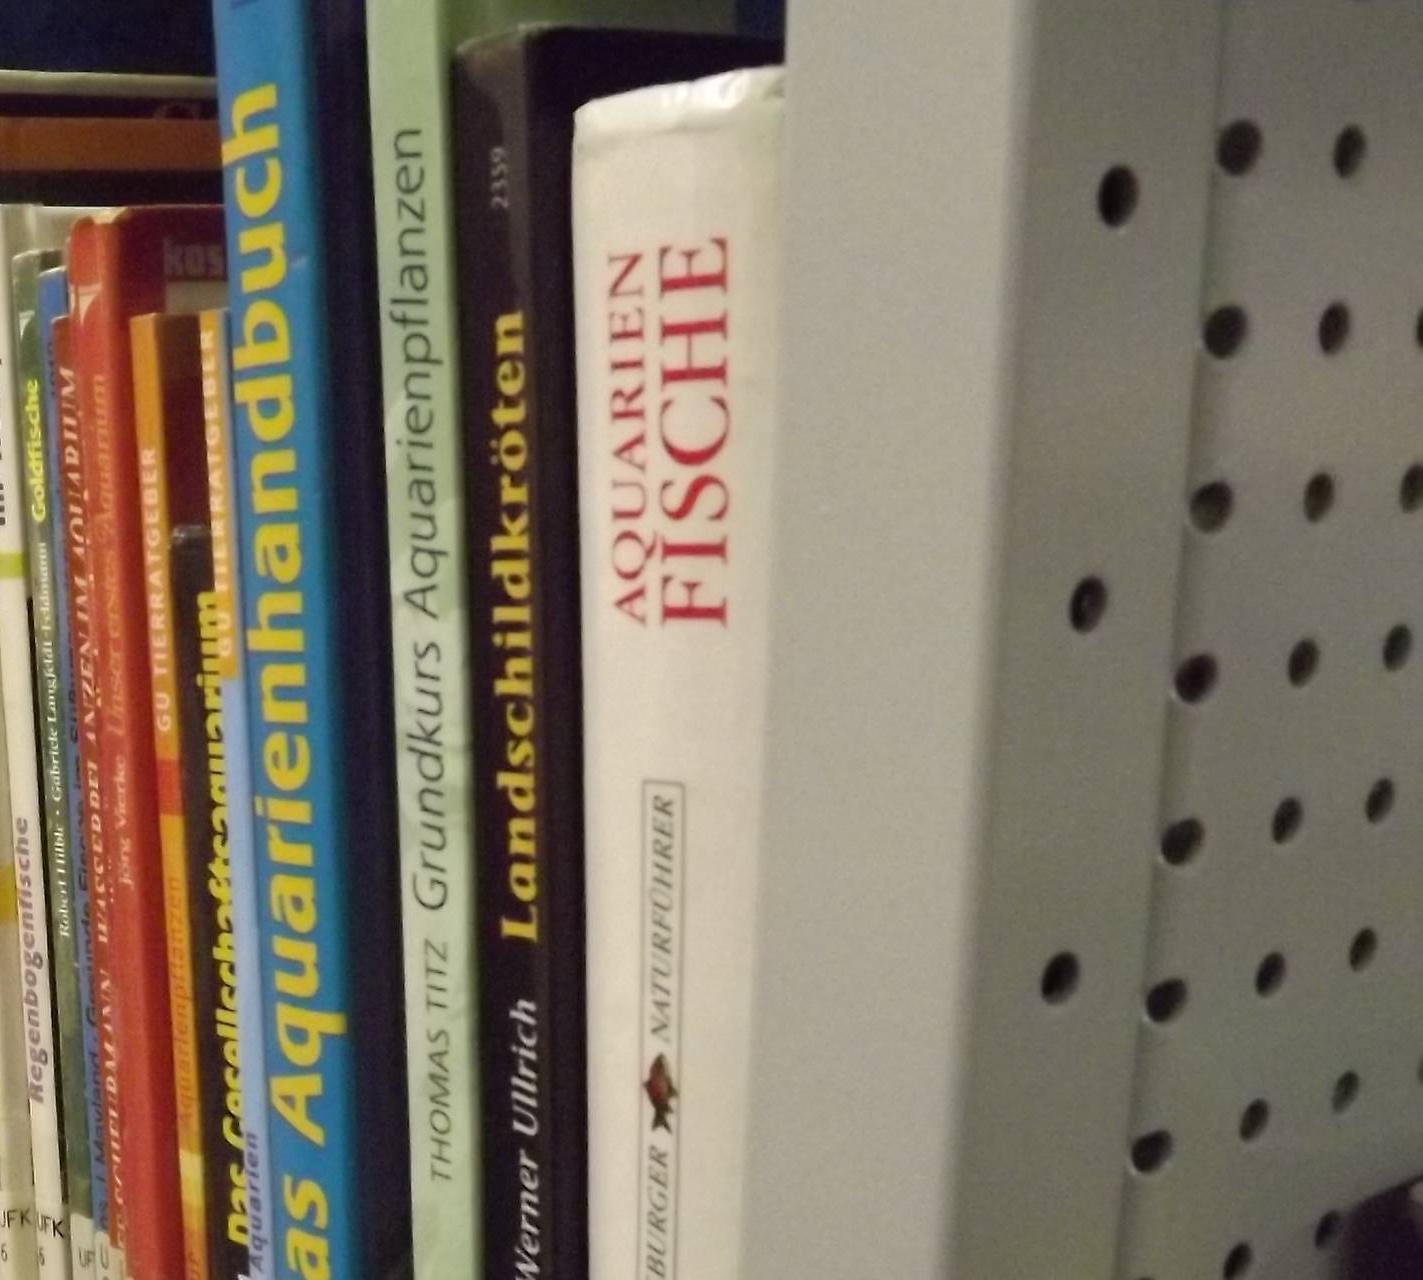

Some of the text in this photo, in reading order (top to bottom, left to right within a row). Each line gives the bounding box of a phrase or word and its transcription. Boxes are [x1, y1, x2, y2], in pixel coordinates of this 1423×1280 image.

[162, 237, 225, 277] kos
[491, 146, 509, 209] 2359
[22, 379, 48, 522] Goldfische
[199, 329, 230, 592] TIERRATGEBER
[608, 252, 658, 627] AQUARIEN
[658, 237, 731, 628] FISCHE
[140, 447, 168, 677] TIERRATGEBER
[389, 127, 453, 1183] THOMAS TITZ Grundkurs Aquarienpflanzen
[157, 692, 172, 733] GU
[221, 84, 346, 1280] as Aquarienhandbuch
[490, 310, 541, 1280] Werner Ullrich Landschildkröten
[15, 816, 49, 1104] Regenbogenfische
[57, 878, 70, 938] Robert
[645, 794, 677, 1280] BURGER NATURFÜHRER
[1, 1242, 9, 1263] 6
[37, 1211, 65, 1239] UFK
[78, 1246, 96, 1269] UF
[247, 1131, 268, 1274] Aquarien
